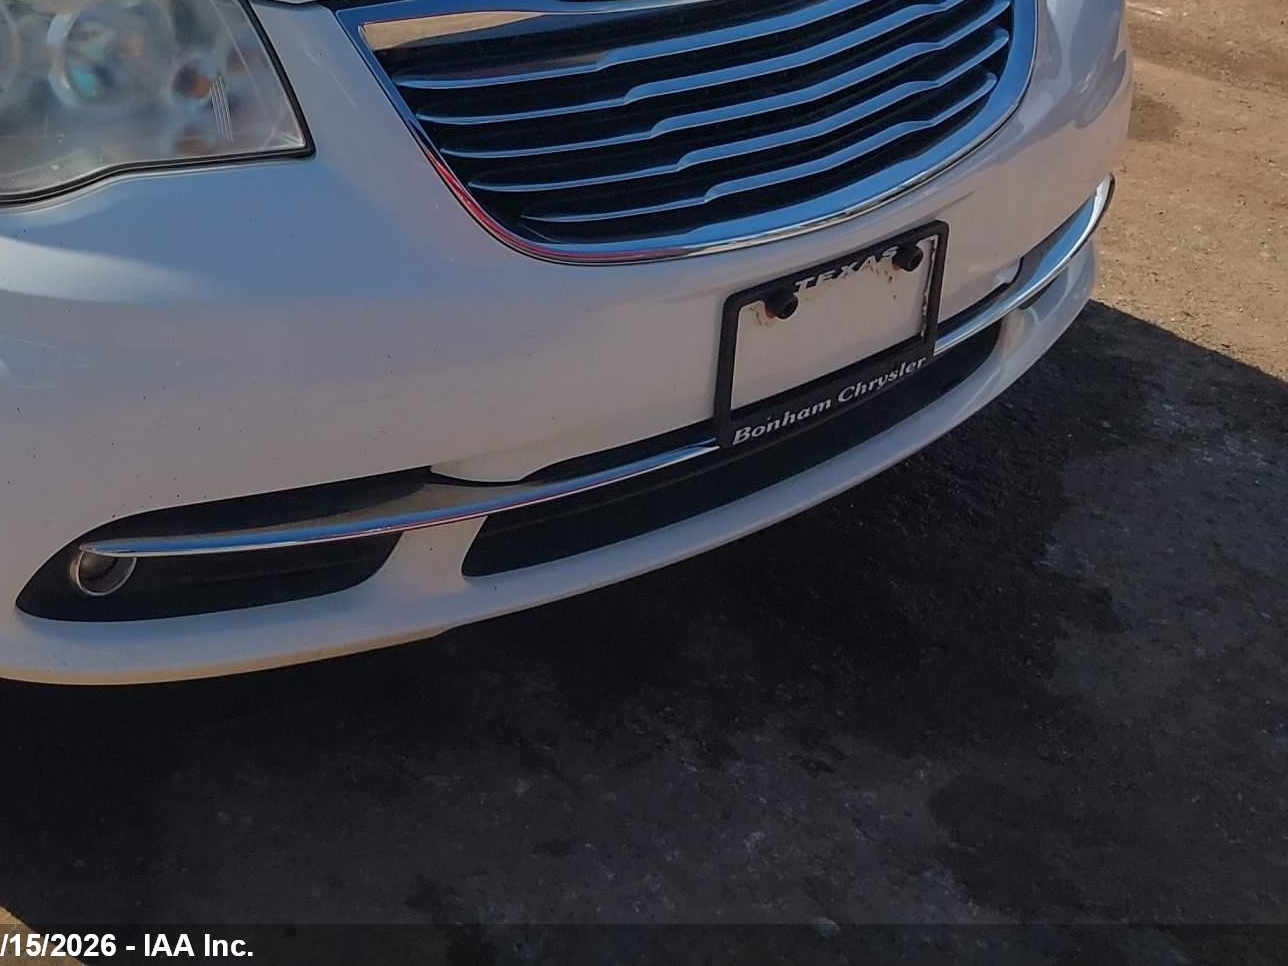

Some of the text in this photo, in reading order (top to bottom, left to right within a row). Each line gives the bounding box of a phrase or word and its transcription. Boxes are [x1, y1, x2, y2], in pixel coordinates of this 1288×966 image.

[794, 246, 899, 290] TEXAS
[732, 357, 926, 446] Bonham Chrysler
